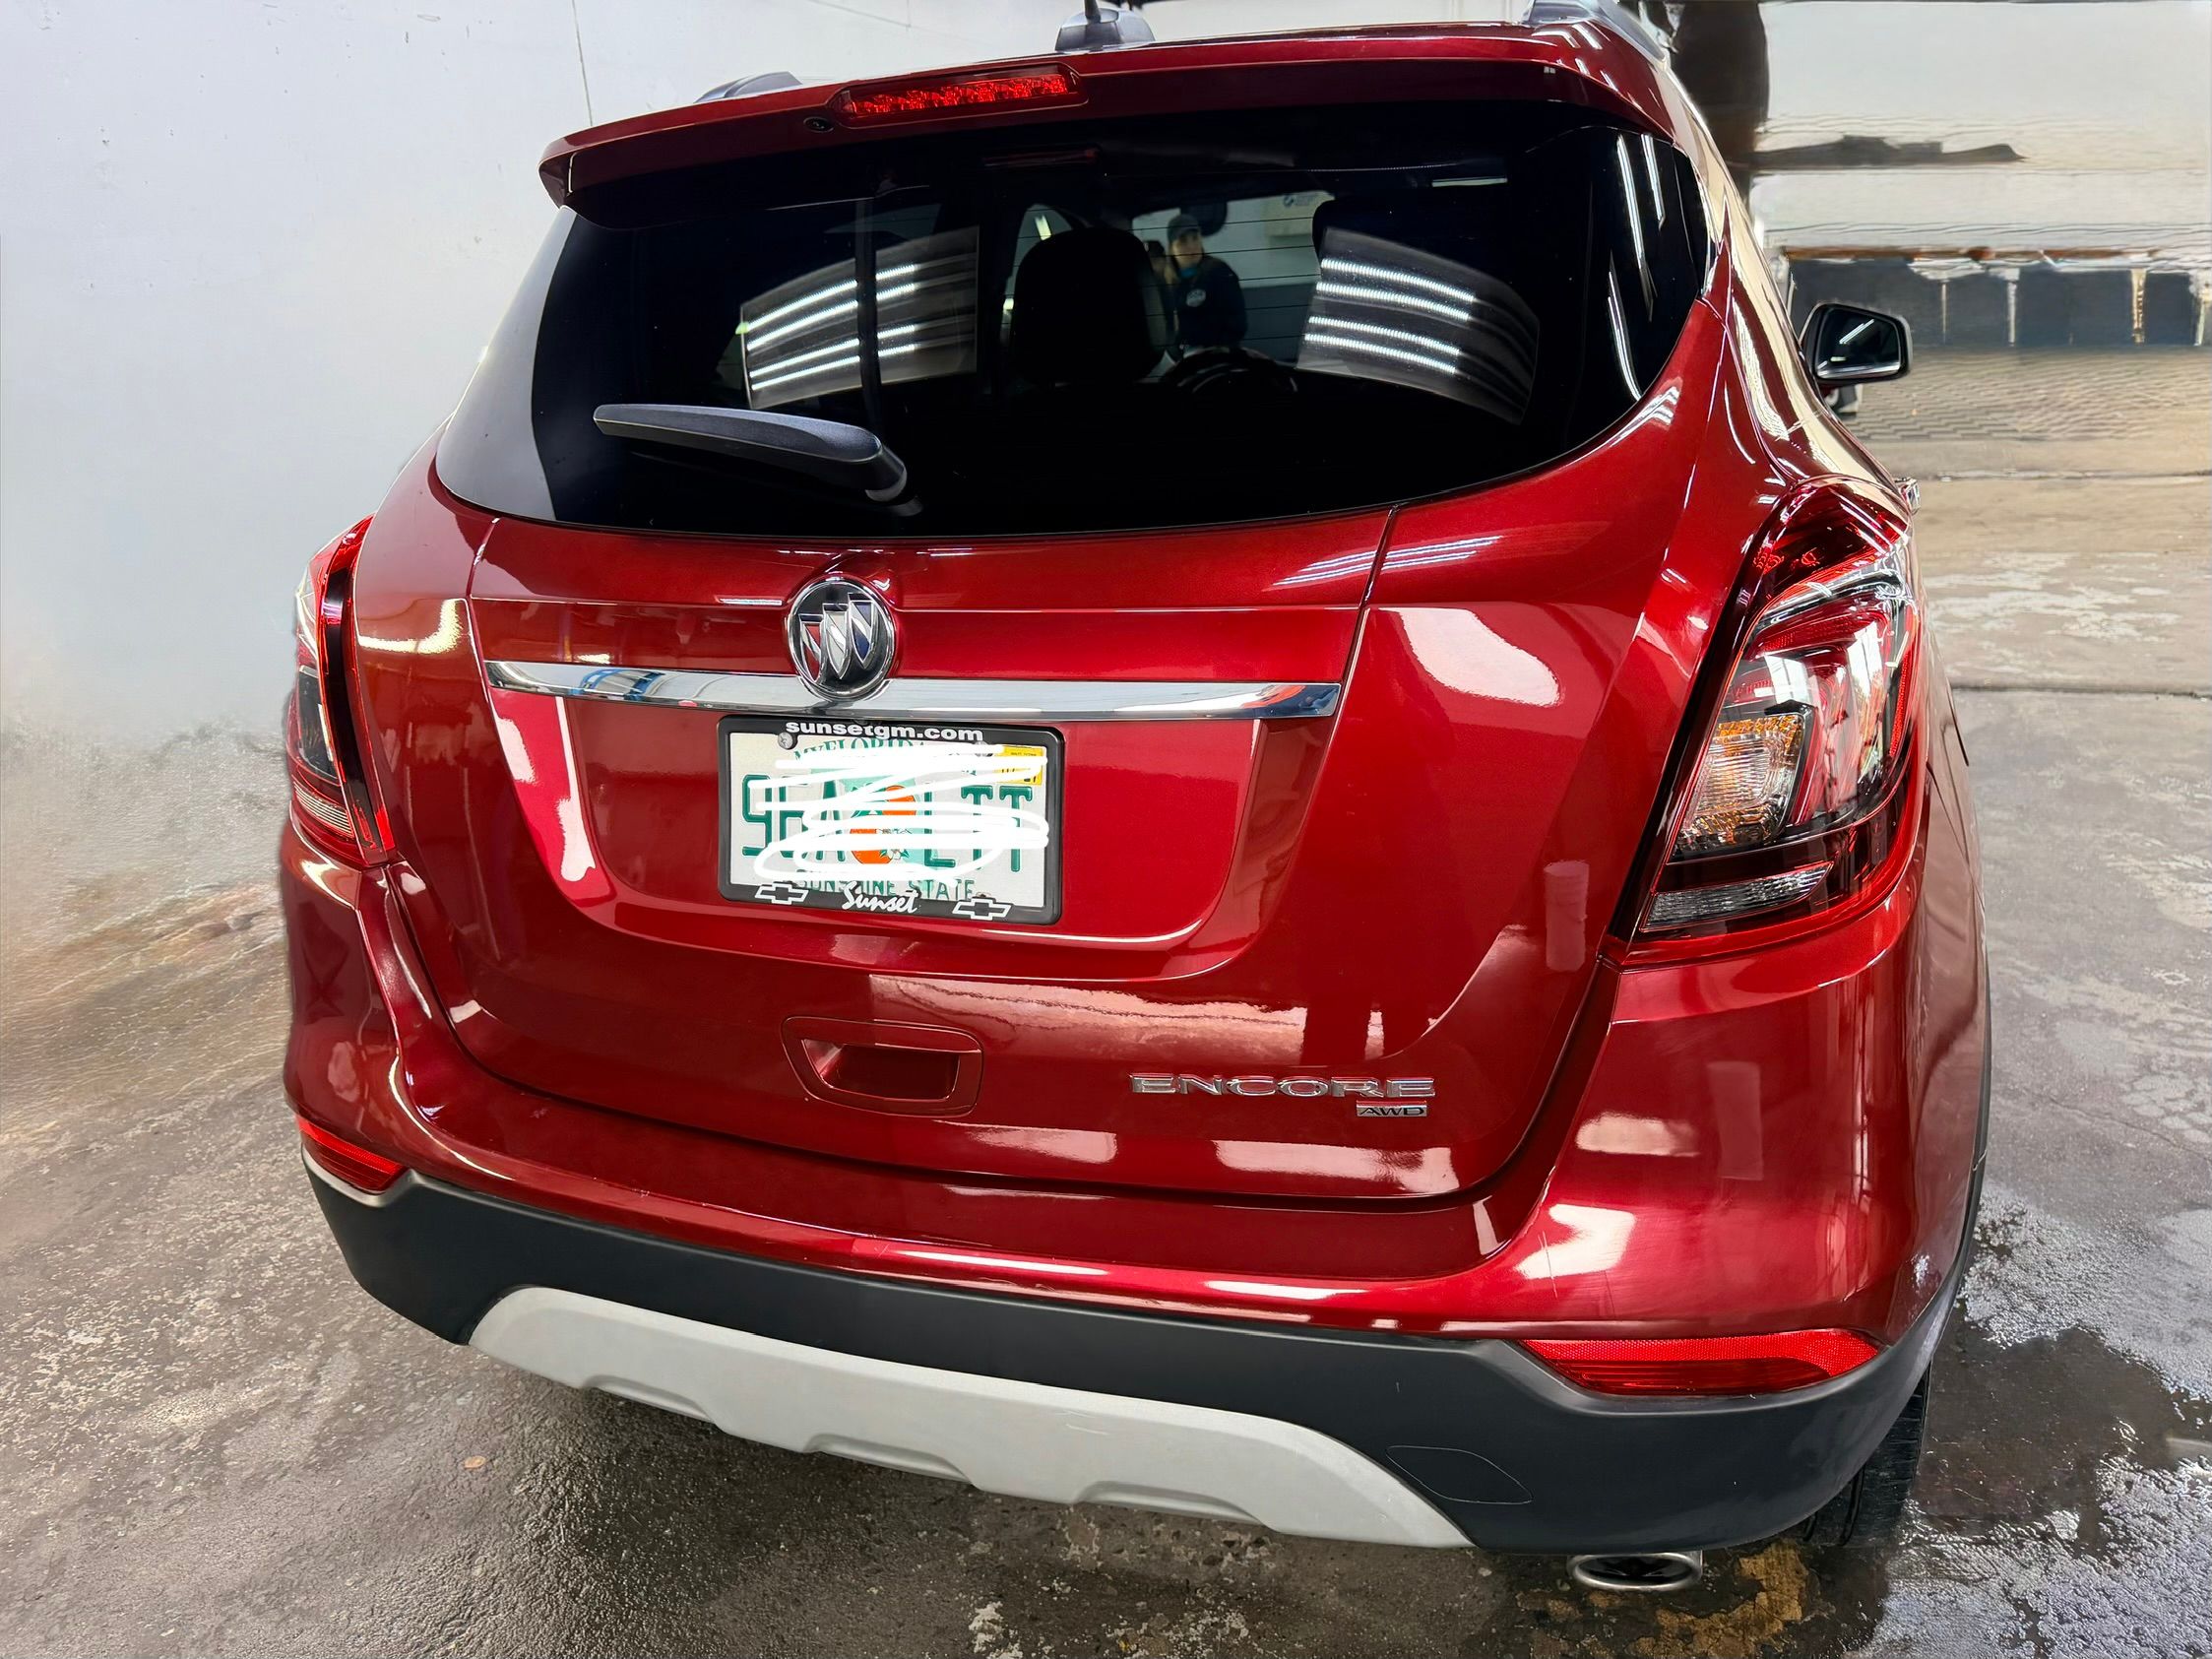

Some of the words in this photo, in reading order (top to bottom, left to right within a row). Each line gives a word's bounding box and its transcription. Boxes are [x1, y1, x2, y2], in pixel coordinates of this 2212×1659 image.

[786, 721, 982, 741] sunsetgm.com
[842, 880, 918, 913] Sunset
[1130, 1073, 1435, 1098] ENCORE
[1359, 1104, 1425, 1117] AWD
